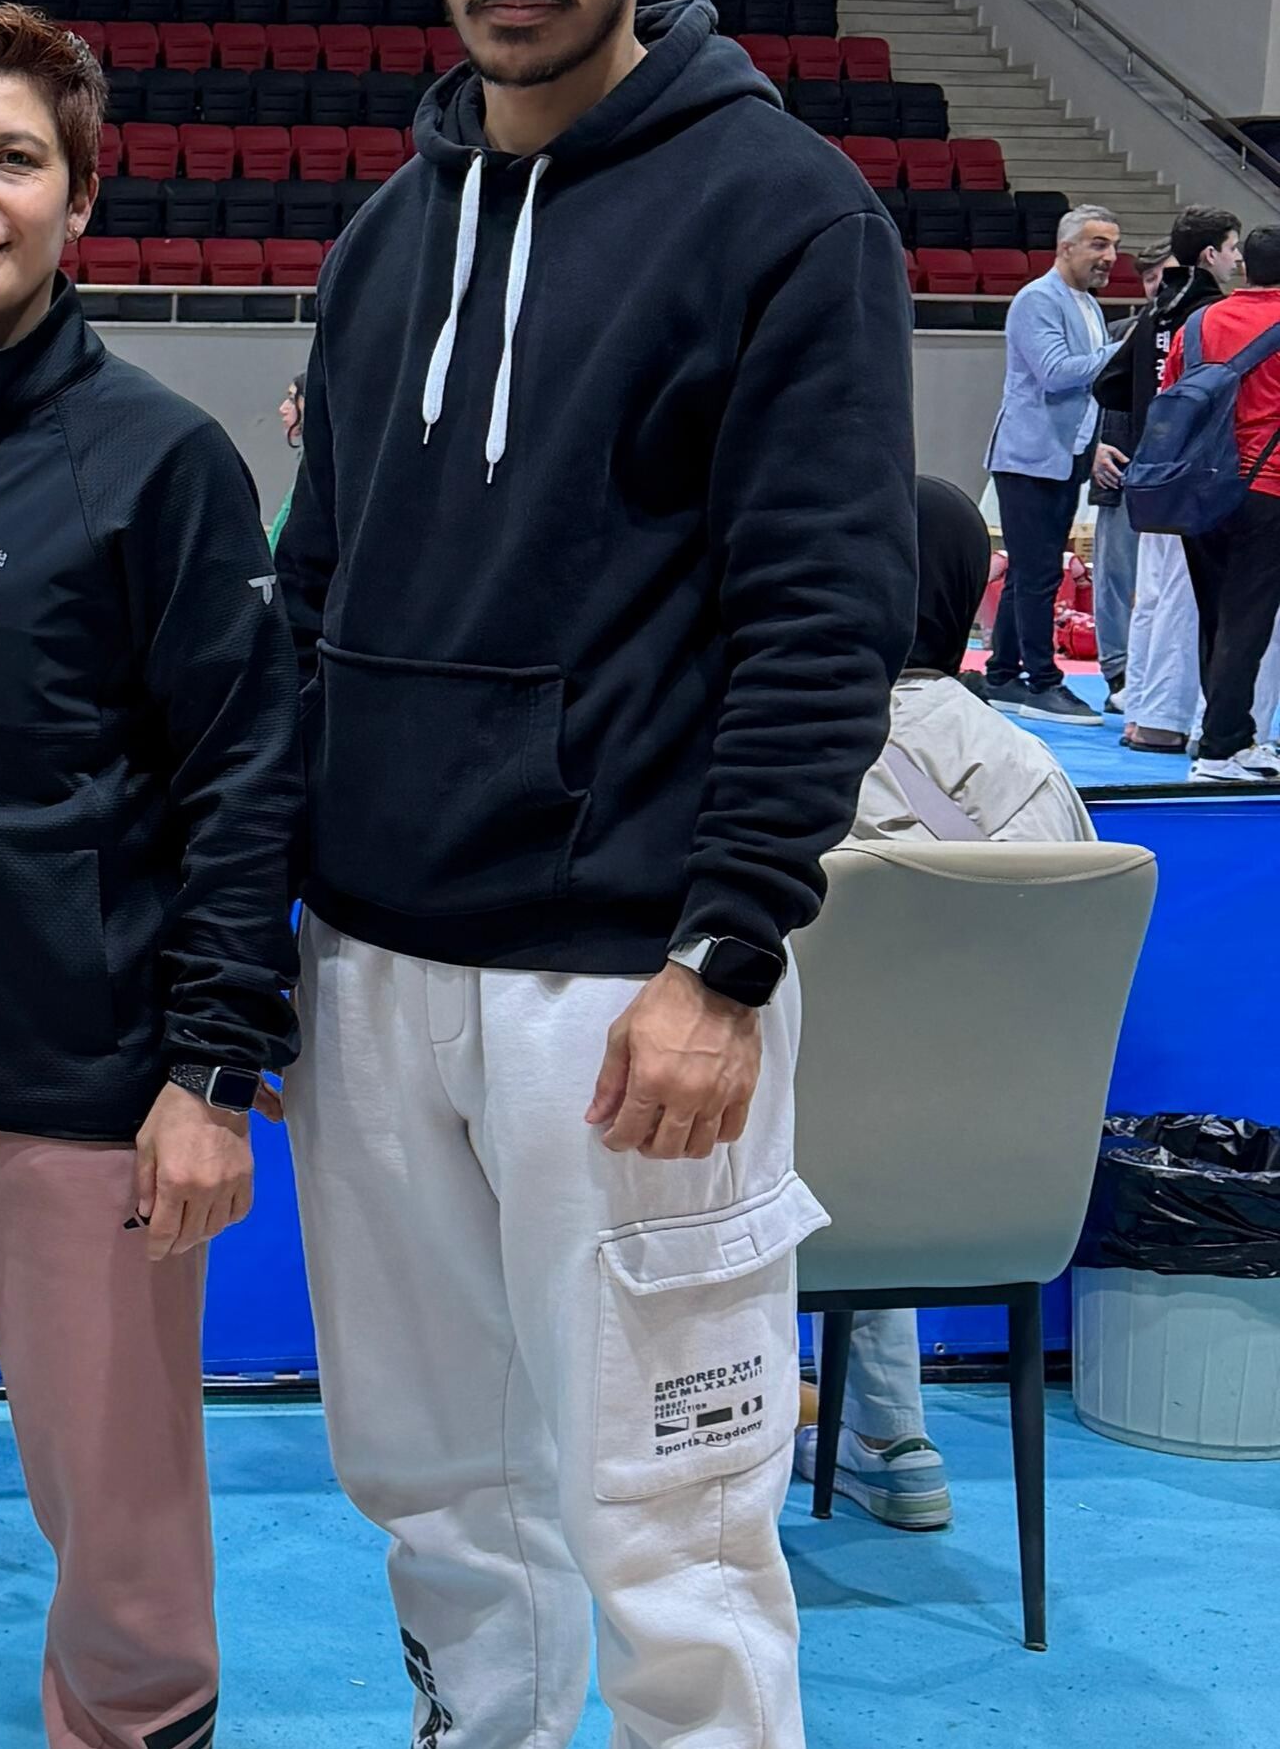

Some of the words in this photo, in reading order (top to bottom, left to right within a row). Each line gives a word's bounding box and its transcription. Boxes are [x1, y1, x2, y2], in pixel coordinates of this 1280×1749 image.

[655, 1367, 727, 1393] ERRORED
[655, 1437, 700, 1456] Sports
[706, 1419, 763, 1443] Academy
